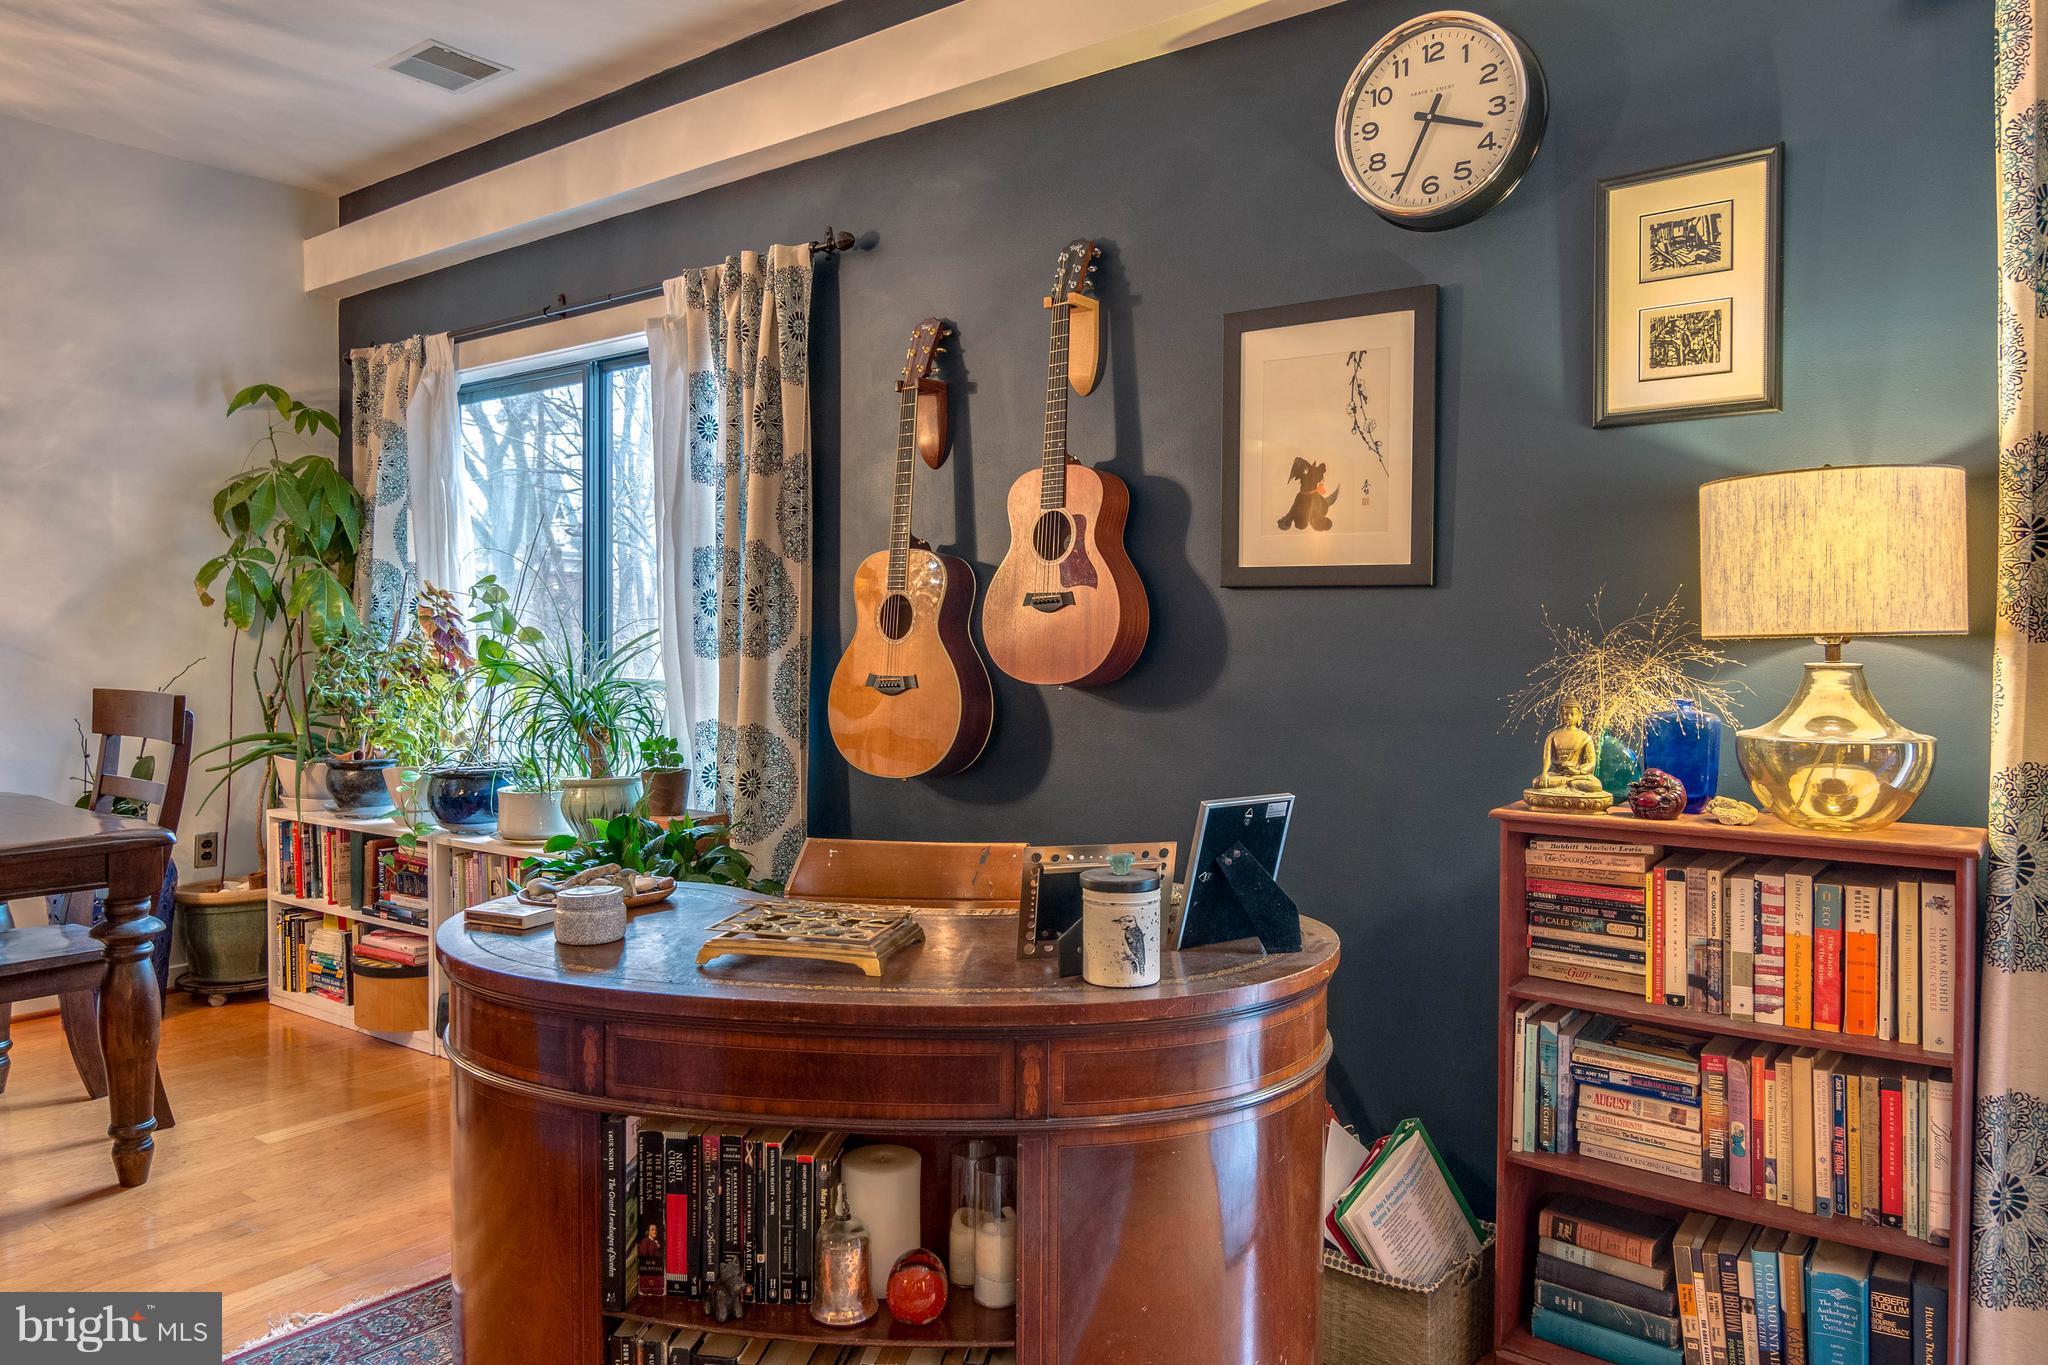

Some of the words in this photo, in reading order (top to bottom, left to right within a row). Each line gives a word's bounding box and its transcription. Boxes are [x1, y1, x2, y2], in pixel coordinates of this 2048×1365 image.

[1422, 42, 1445, 63] 12
[1462, 44, 1469, 63] 1
[1392, 58, 1409, 79] 11
[1479, 64, 1498, 84] 2
[1369, 87, 1393, 107] 10
[1488, 96, 1506, 115] 3
[1361, 122, 1379, 141] 9
[1477, 132, 1496, 151] 4
[1369, 153, 1386, 172] 8
[1454, 160, 1472, 180] 5
[1422, 176, 1439, 194] 6
[1794, 879, 1803, 911] Umberto
[1563, 905, 1579, 913] SISTER
[1580, 907, 1600, 916] CARRIE
[1795, 912, 1804, 926] Eco
[1822, 906, 1831, 926] ECO
[1545, 916, 1569, 926] CALEB
[1572, 919, 1593, 929] CARR
[1929, 927, 1937, 943] THE
[1939, 927, 1948, 966] SALMAN
[1929, 944, 1937, 980] SATANIC
[1568, 967, 1591, 981] Garp
[1939, 970, 1948, 1013] RUSHDIE
[1708, 1075, 1723, 1089] DAN
[1835, 1078, 1843, 1089] Jack
[1593, 1093, 1632, 1111] AUGUST
[1709, 1091, 1723, 1116] BROWN
[1835, 1091, 1843, 1111] Kerouac
[1594, 1114, 1616, 1125] AGATHA
[1617, 1119, 1643, 1131] CHRISTIE
[1835, 1126, 1844, 1137] ON
[1710, 1128, 1724, 1158] INFERNO
[1781, 1126, 1789, 1144] WIFE
[1930, 1116, 1952, 1171] Bandbox
[1835, 1138, 1844, 1152] THE
[668, 1150, 676, 1184] CIRCUS
[675, 1152, 683, 1182] NIGHT
[1835, 1154, 1844, 1175] ROAD
[707, 1175, 715, 1187] The
[608, 1191, 616, 1212] Grand
[820, 1188, 828, 1207] Mary
[705, 1188, 715, 1229] Magician's
[607, 1213, 616, 1246] Landscapes
[706, 1230, 715, 1265] Assistant
[608, 1254, 616, 1277] Sweden
[1721, 1272, 1736, 1293] DAN
[1755, 1262, 1764, 1305] CHARLES
[1765, 1264, 1776, 1299] COLD
[1833, 1302, 1856, 1312] Norton
[1871, 1294, 1909, 1306] ROBERT
[1871, 1301, 1909, 1315] LUDLUM
[1723, 1295, 1741, 1332] BROWN
[1817, 1307, 1850, 1319] Anthology
[1820, 1315, 1842, 1325] Theory
[1757, 1308, 1766, 1347] FRAZIER
[1822, 1323, 1853, 1335] Criticism
[1871, 1318, 1897, 1328] BOURNE
[1871, 1323, 1910, 1336] SUPREMACY
[1925, 1307, 1934, 1340] HUMAN
